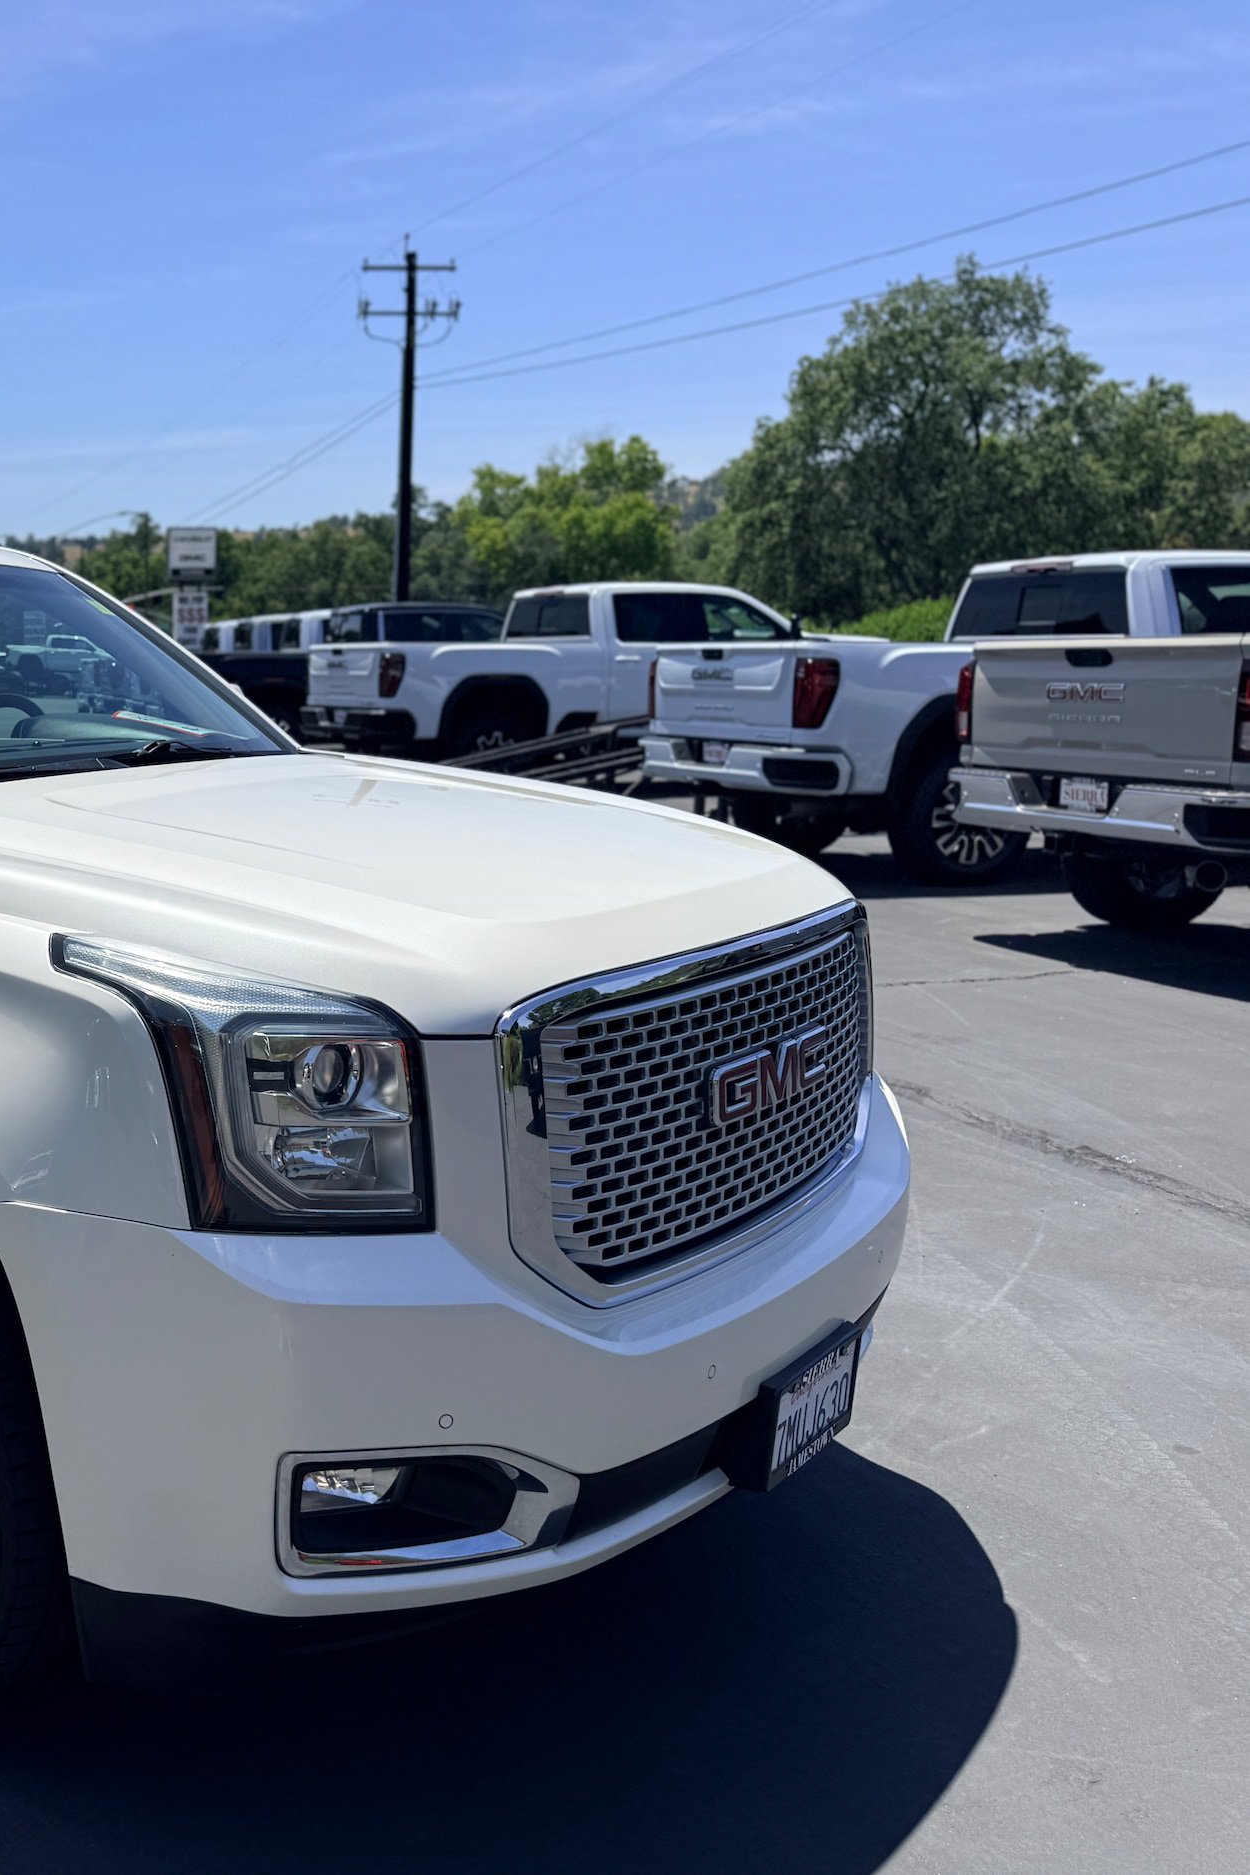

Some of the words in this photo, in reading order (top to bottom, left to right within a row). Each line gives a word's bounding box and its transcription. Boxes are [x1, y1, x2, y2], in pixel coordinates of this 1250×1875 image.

[691, 667, 733, 681] GMC
[1046, 682, 1125, 703] GMC
[1048, 713, 1121, 724] SIERRA
[713, 1025, 827, 1127] GMC
[802, 1346, 842, 1384] SIERRA
[777, 1371, 849, 1465] 7MUJ630
